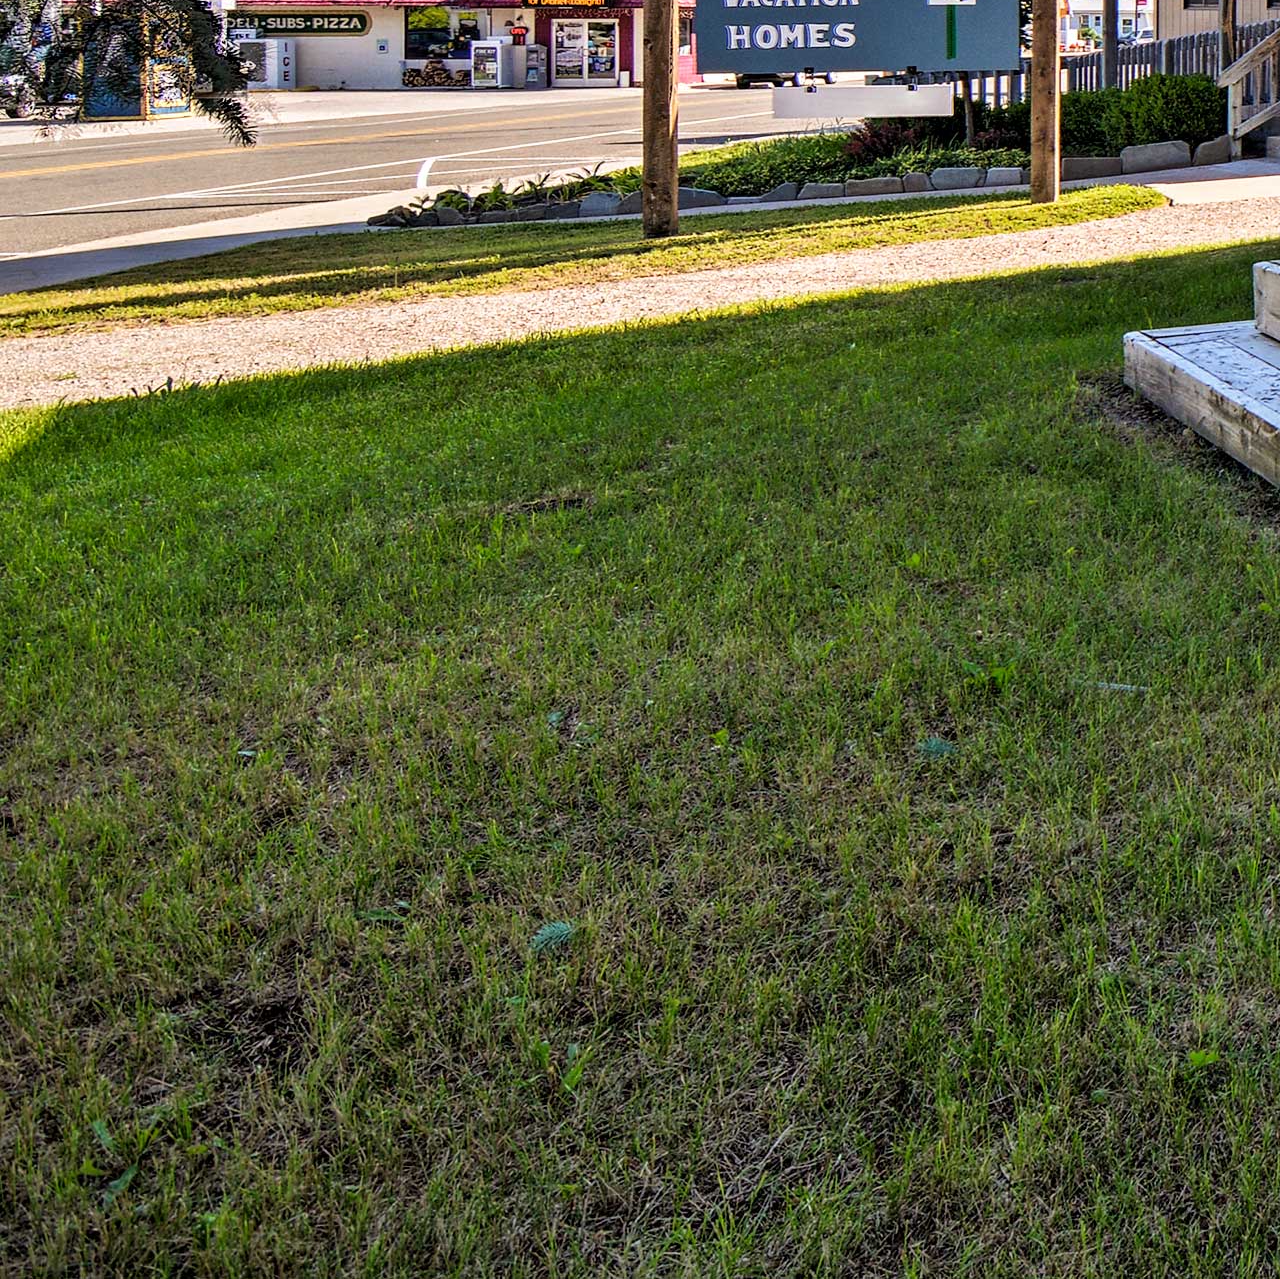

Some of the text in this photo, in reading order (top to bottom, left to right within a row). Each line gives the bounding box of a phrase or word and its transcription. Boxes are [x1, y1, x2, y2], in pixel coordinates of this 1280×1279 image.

[227, 17, 362, 29] DELI SUBS PIZZA
[725, 23, 857, 49] HOMES
